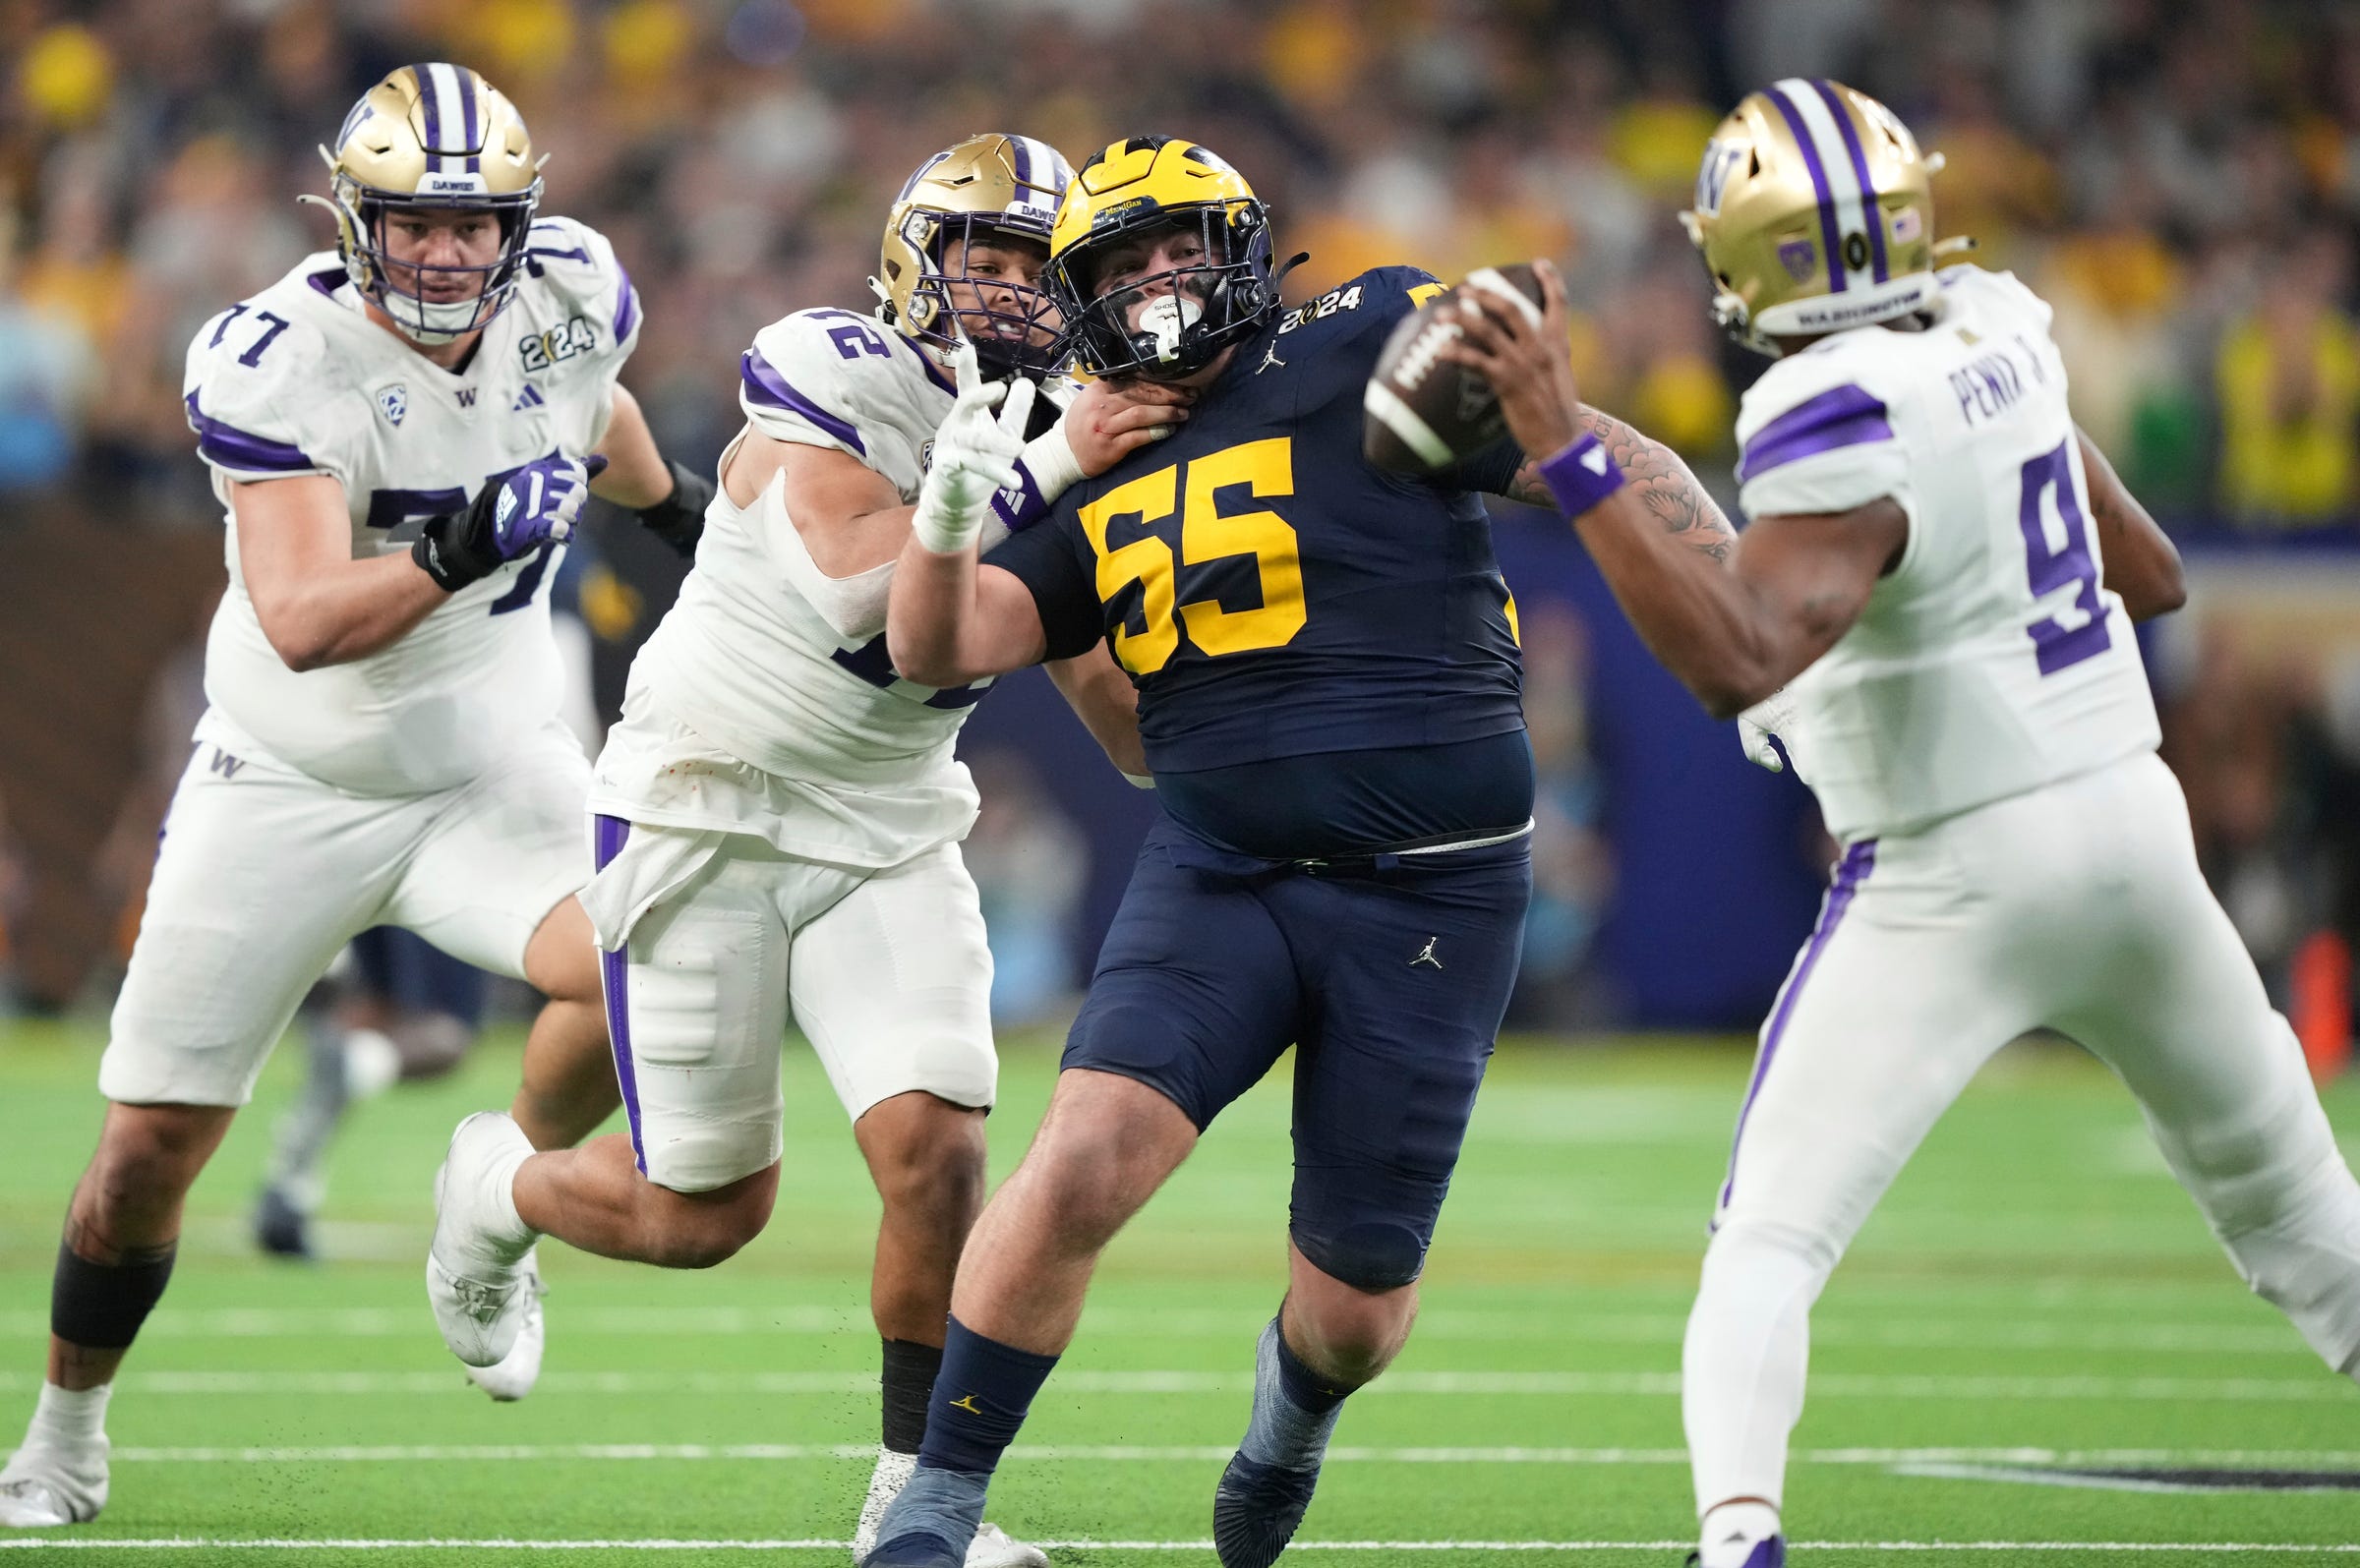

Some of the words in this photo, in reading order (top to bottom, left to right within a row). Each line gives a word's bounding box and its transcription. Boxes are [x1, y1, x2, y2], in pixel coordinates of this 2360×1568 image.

[1022, 204, 1056, 223] DAWG
[1154, 302, 1178, 311] SHOC
[1277, 285, 1366, 335] 2024
[207, 303, 290, 369] 77
[454, 387, 478, 409] W
[1077, 436, 1308, 676] 55
[2020, 436, 2112, 677] 9
[209, 747, 246, 780] W
